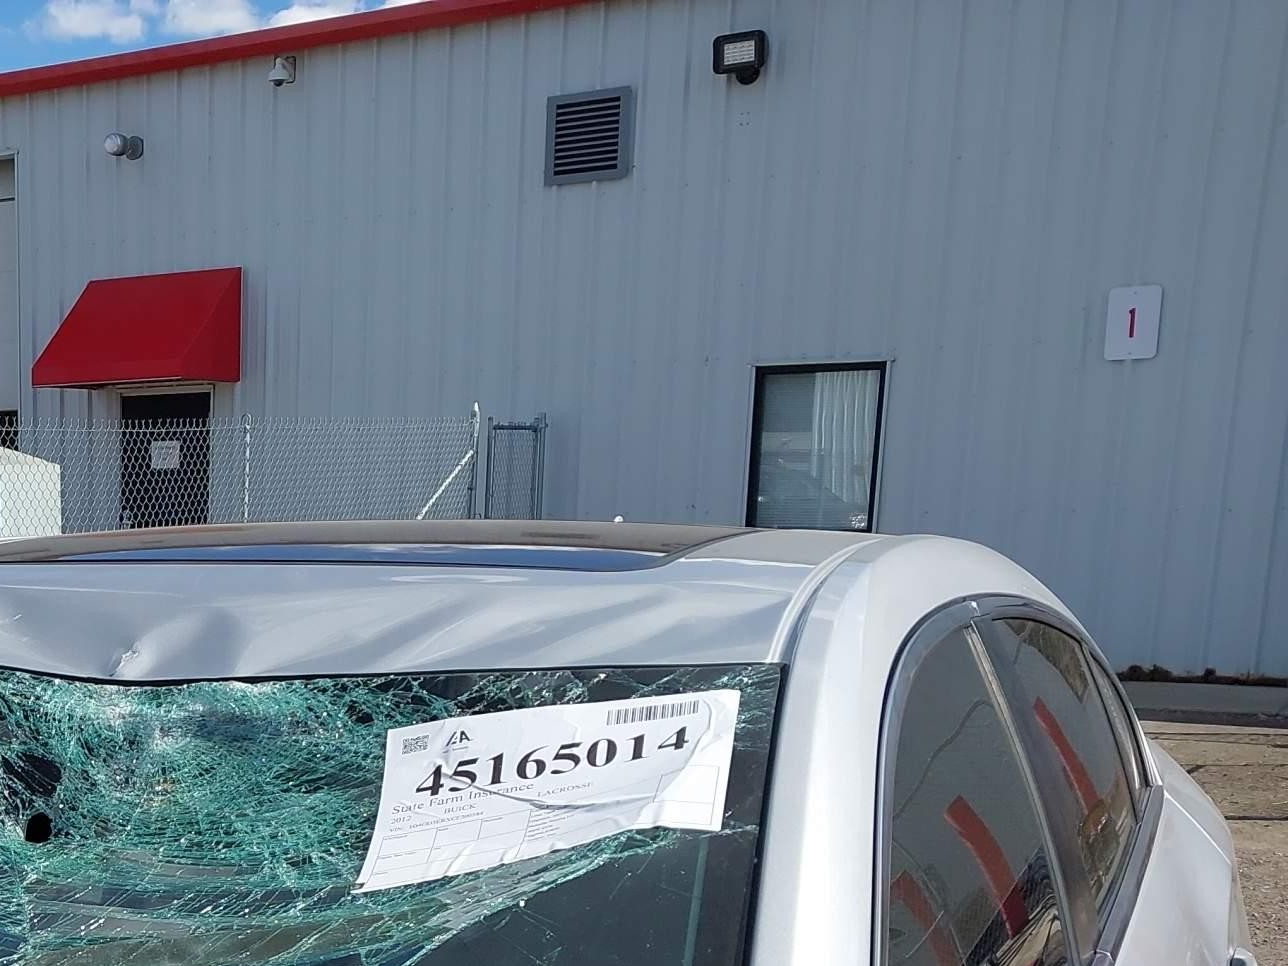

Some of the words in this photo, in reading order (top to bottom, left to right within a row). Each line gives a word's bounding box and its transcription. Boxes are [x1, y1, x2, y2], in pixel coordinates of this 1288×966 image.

[1128, 307, 1137, 339] 1
[415, 725, 690, 797] 45165014
[391, 801, 425, 815] State
[429, 795, 463, 808] Farm
[390, 815, 413, 825] 2012
